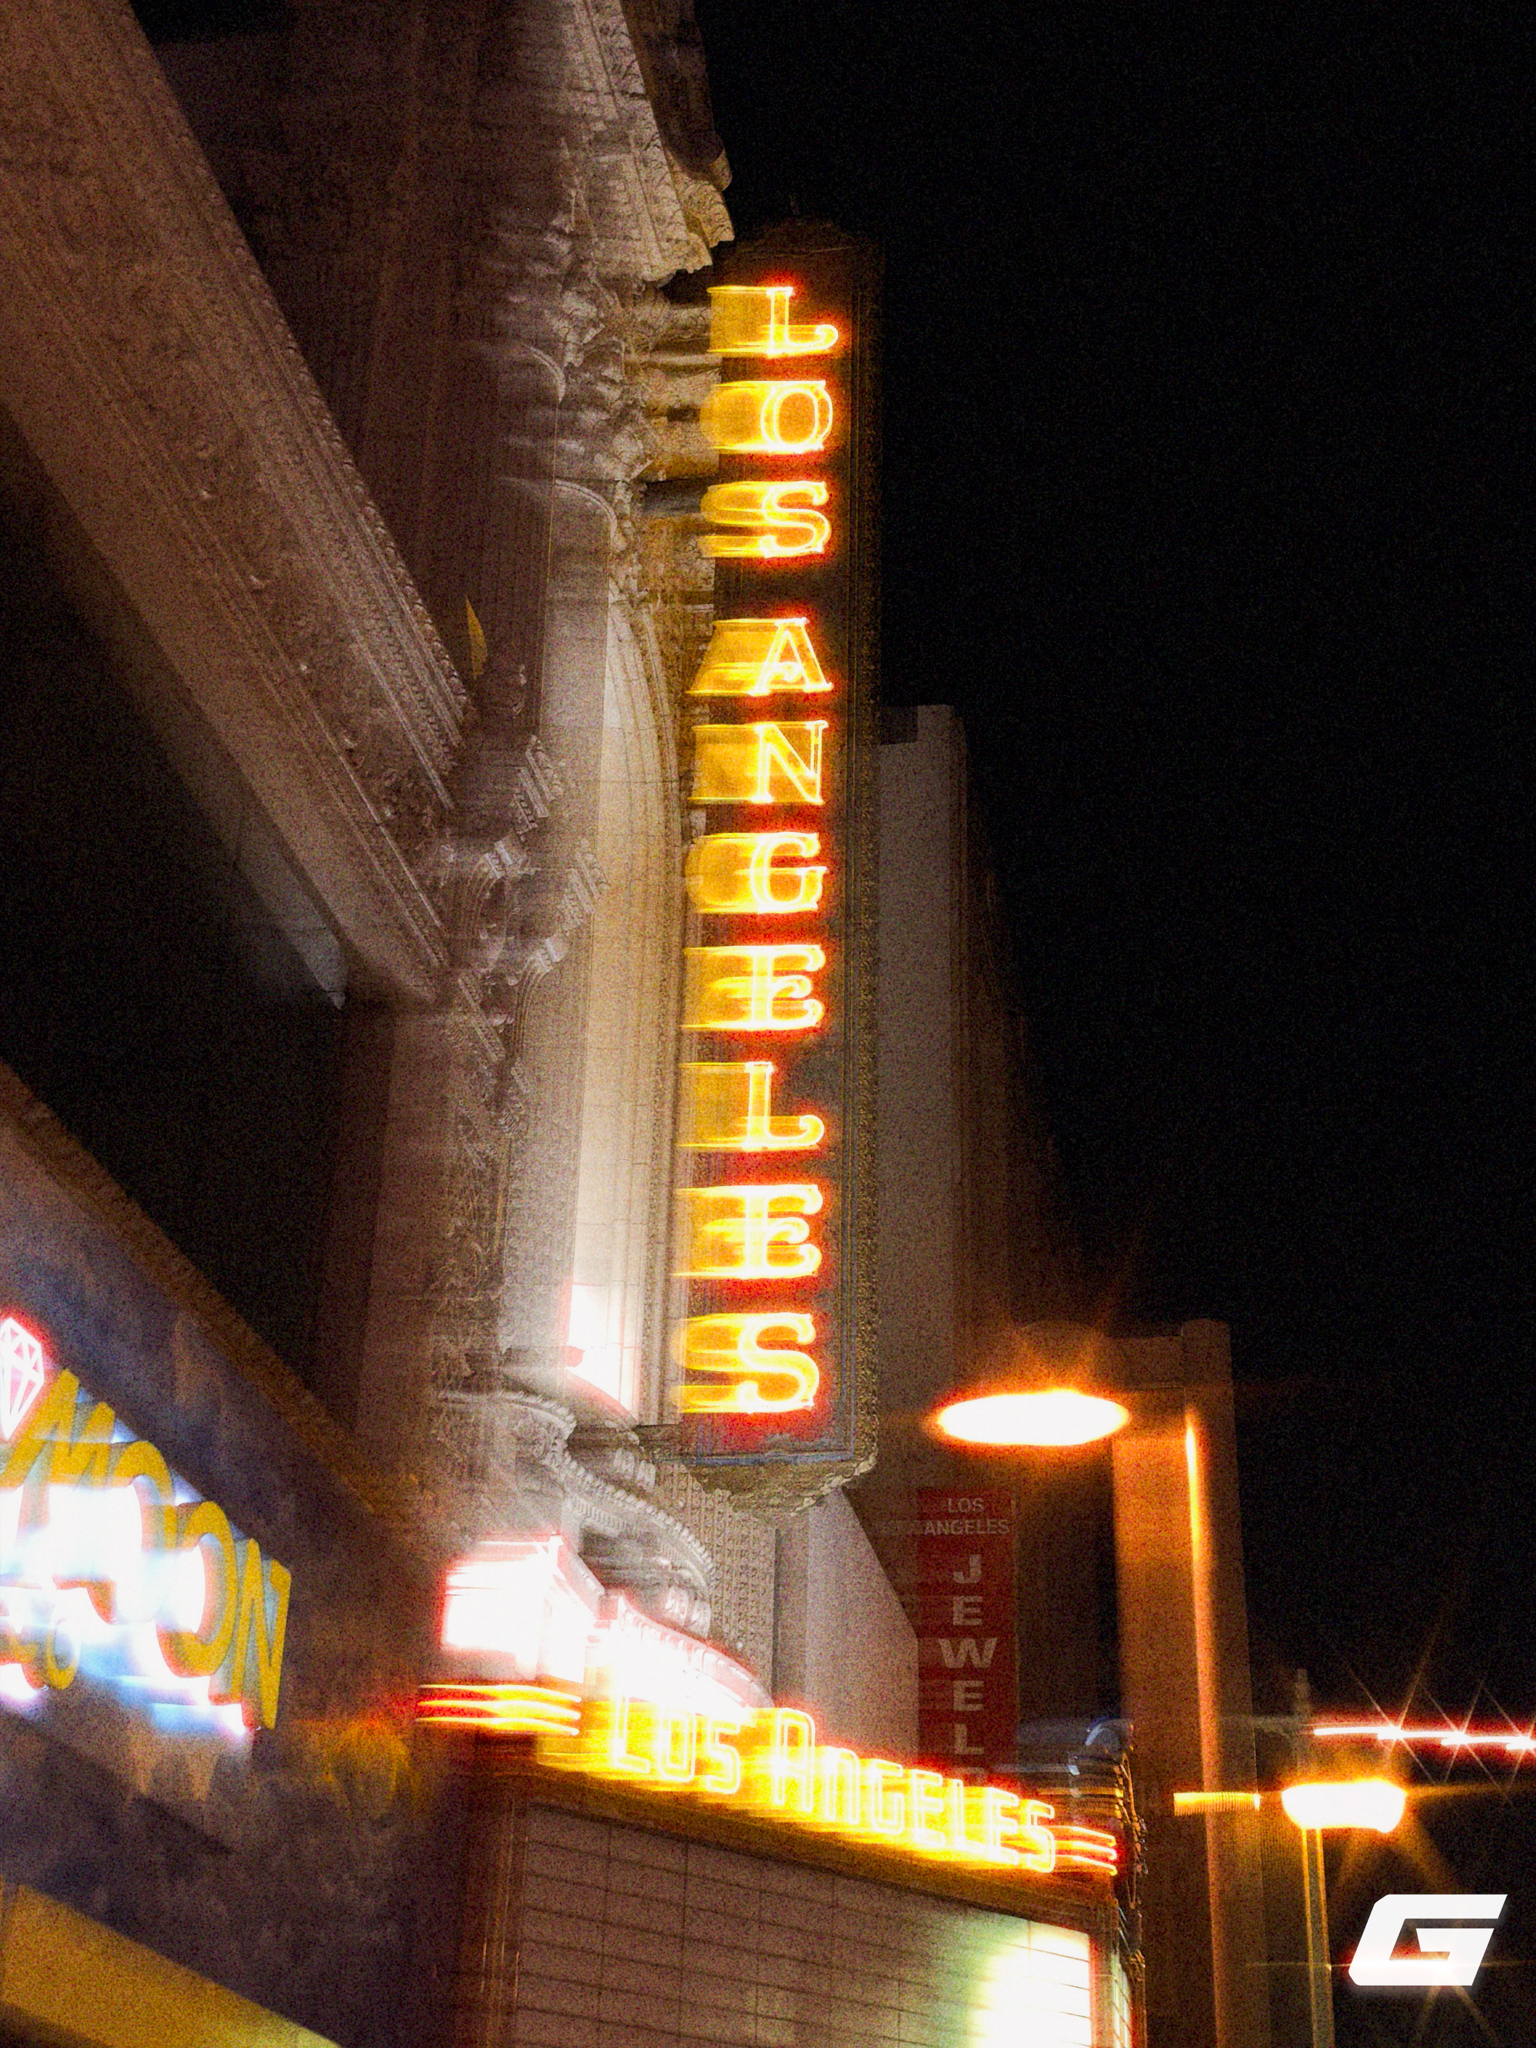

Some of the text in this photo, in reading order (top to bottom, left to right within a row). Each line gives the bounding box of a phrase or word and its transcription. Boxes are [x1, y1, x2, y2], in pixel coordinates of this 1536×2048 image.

[715, 285, 839, 1412] LOS ANGELES
[924, 1518, 1010, 1536] ANGELES
[947, 1498, 985, 1514] LOS
[604, 1692, 1057, 1873] LOS ANGELES
